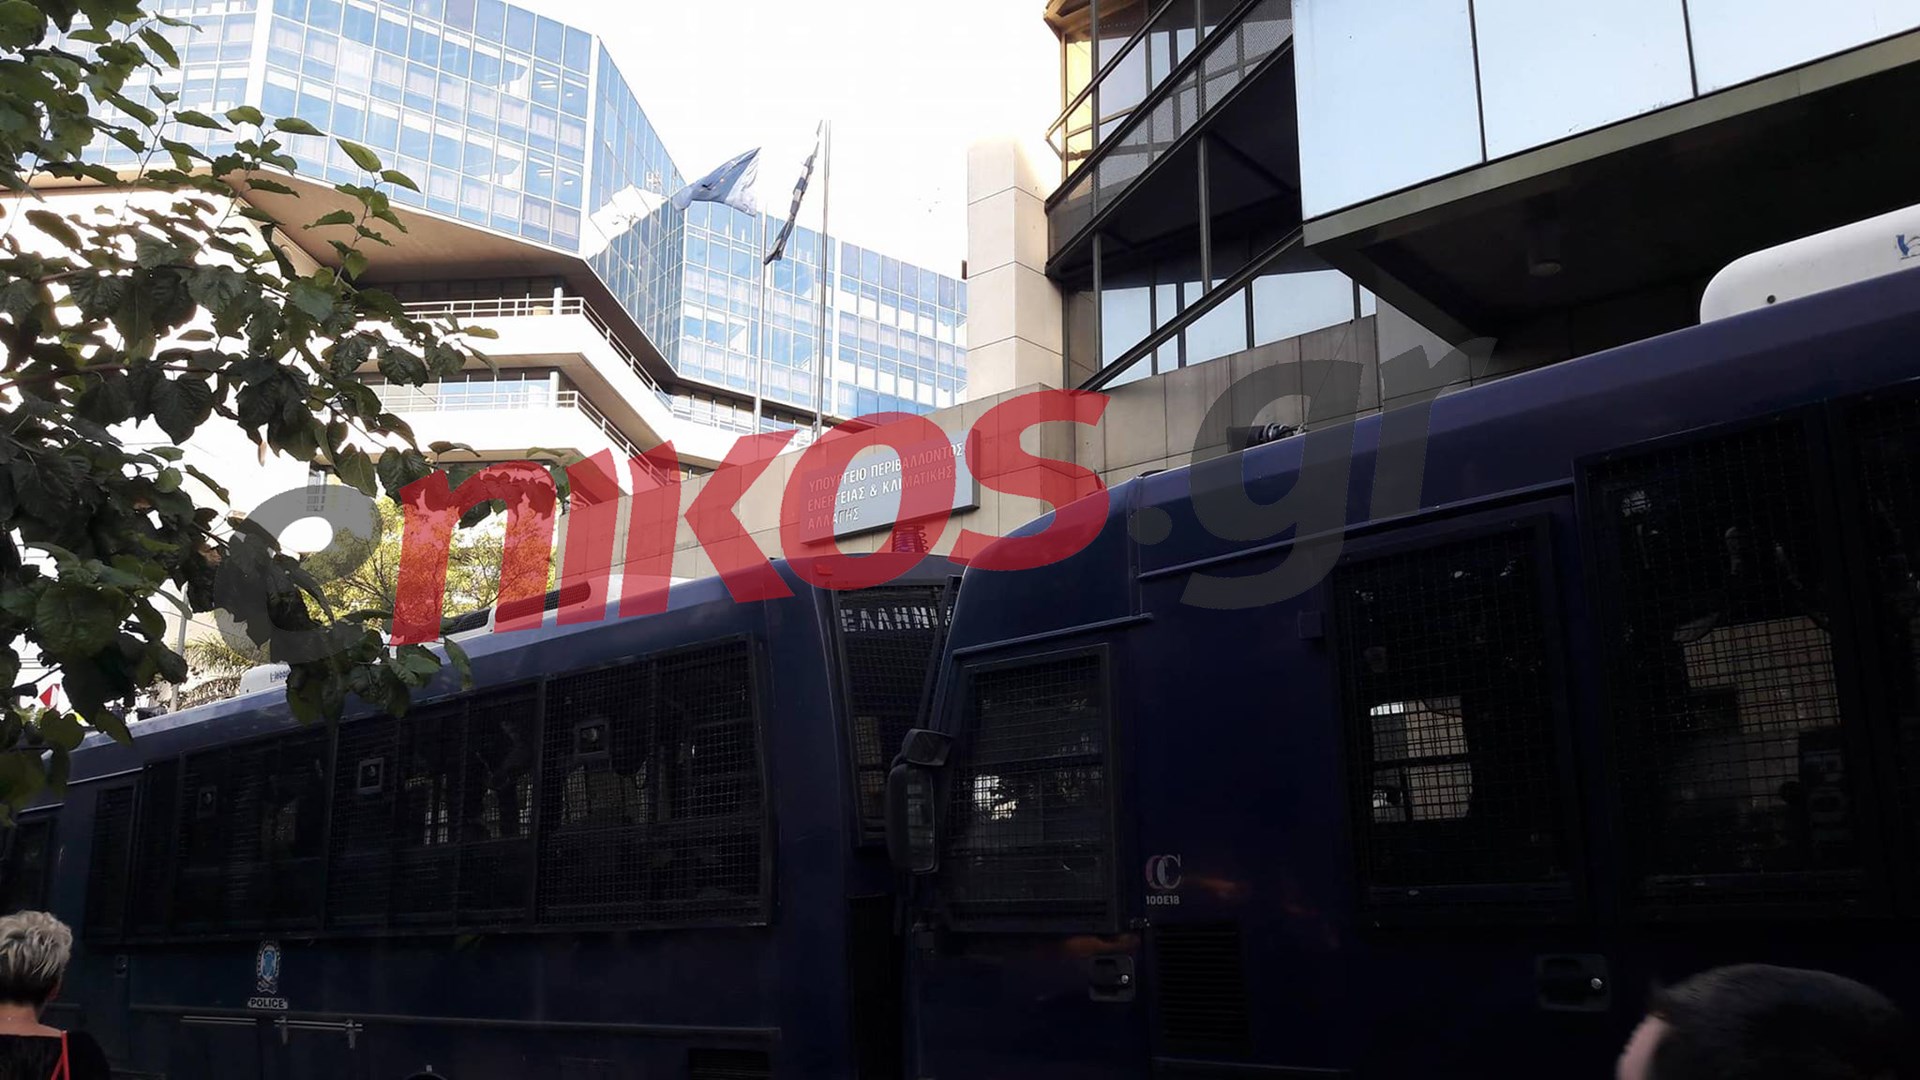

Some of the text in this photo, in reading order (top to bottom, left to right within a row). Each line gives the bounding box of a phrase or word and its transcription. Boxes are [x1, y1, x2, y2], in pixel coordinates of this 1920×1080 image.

[809, 442, 964, 493] ΥΠΟΥΡΓΕΙΟ ΠΕΡΙΒΑΛΛΟΝΤΟΣ
[807, 464, 953, 512] ΕΝΕΡΓΕΙΑΣ & ΚΛΙΜΑΤΙΚΗΣ
[807, 505, 860, 531] ΑΛΛΑΓΗΣ
[250, 998, 285, 1009] POLICE
